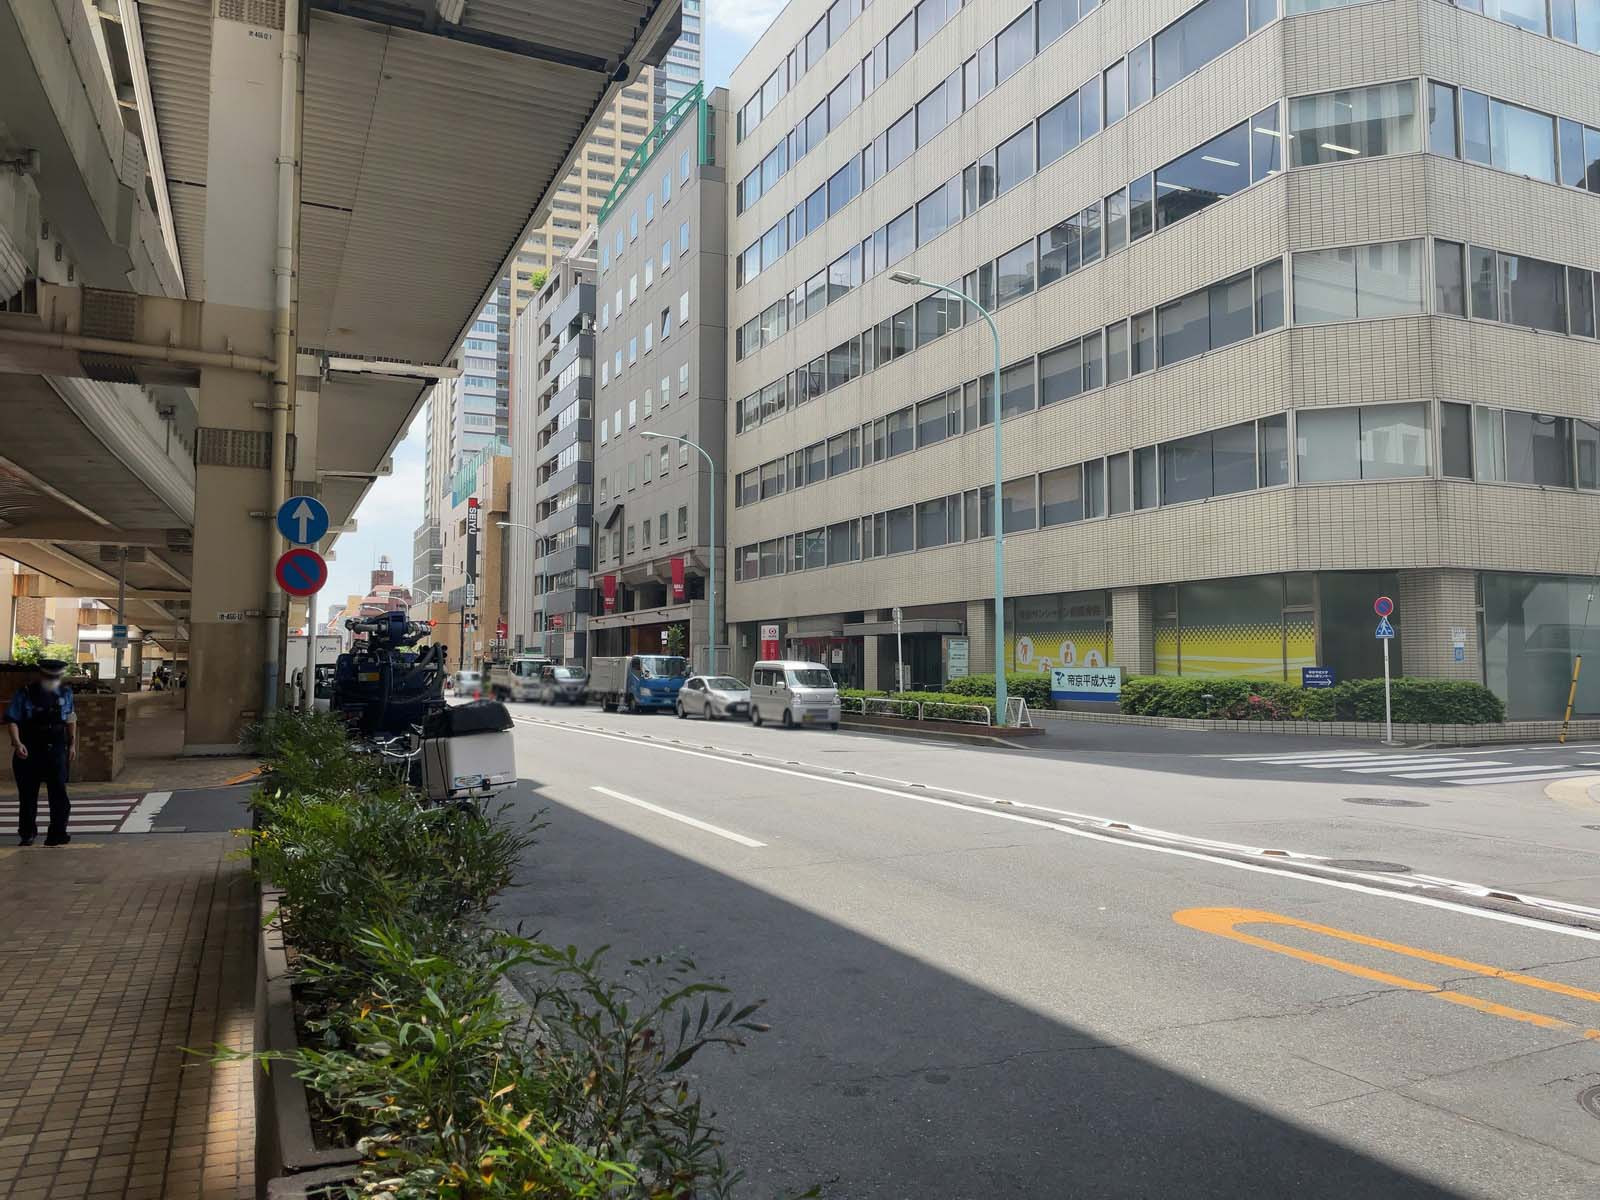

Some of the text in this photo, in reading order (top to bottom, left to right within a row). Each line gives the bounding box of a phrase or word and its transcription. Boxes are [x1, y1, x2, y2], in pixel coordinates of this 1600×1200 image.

[468, 507, 477, 535] SEIYU
[1067, 674, 1117, 688] 帝京平成大学
